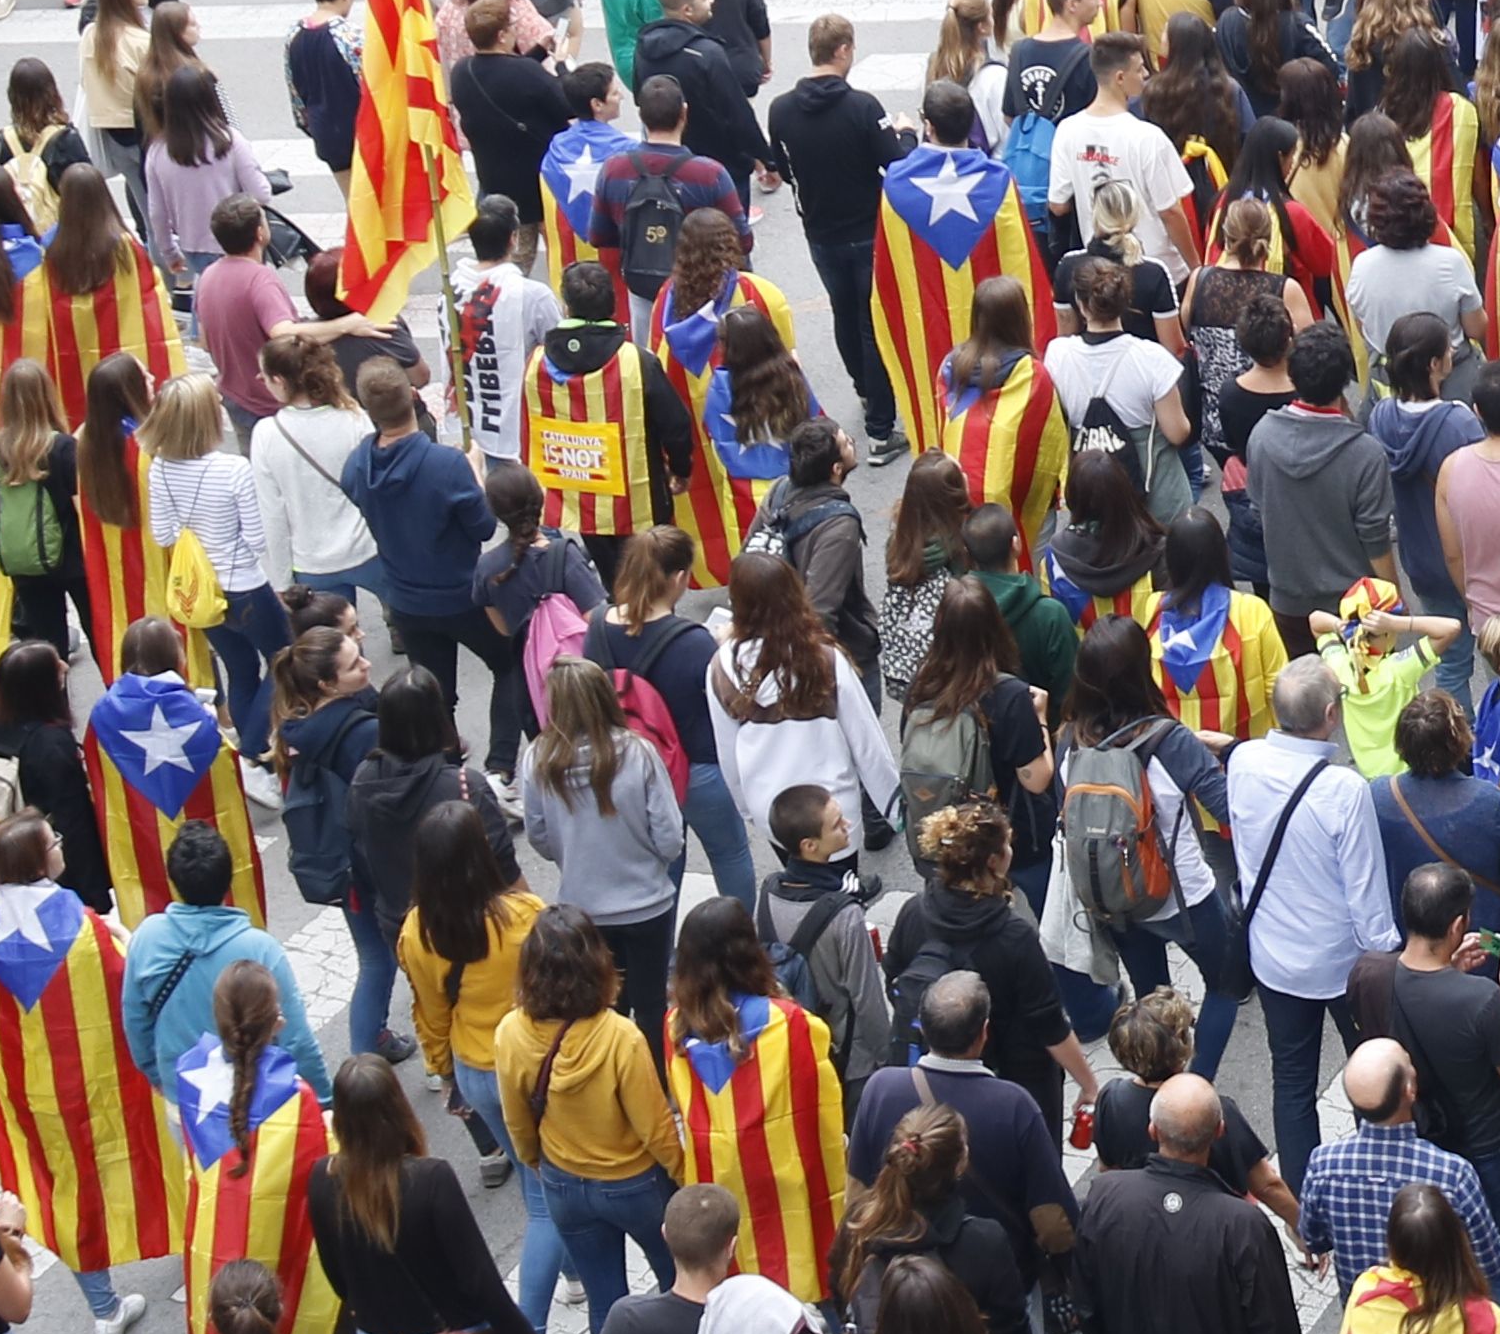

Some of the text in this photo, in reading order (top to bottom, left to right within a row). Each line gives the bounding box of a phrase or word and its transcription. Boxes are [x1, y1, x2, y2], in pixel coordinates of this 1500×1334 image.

[542, 431, 602, 447] CATALUNYA
[543, 444, 603, 469] IS NOT
[558, 467, 591, 481] SPAIN
